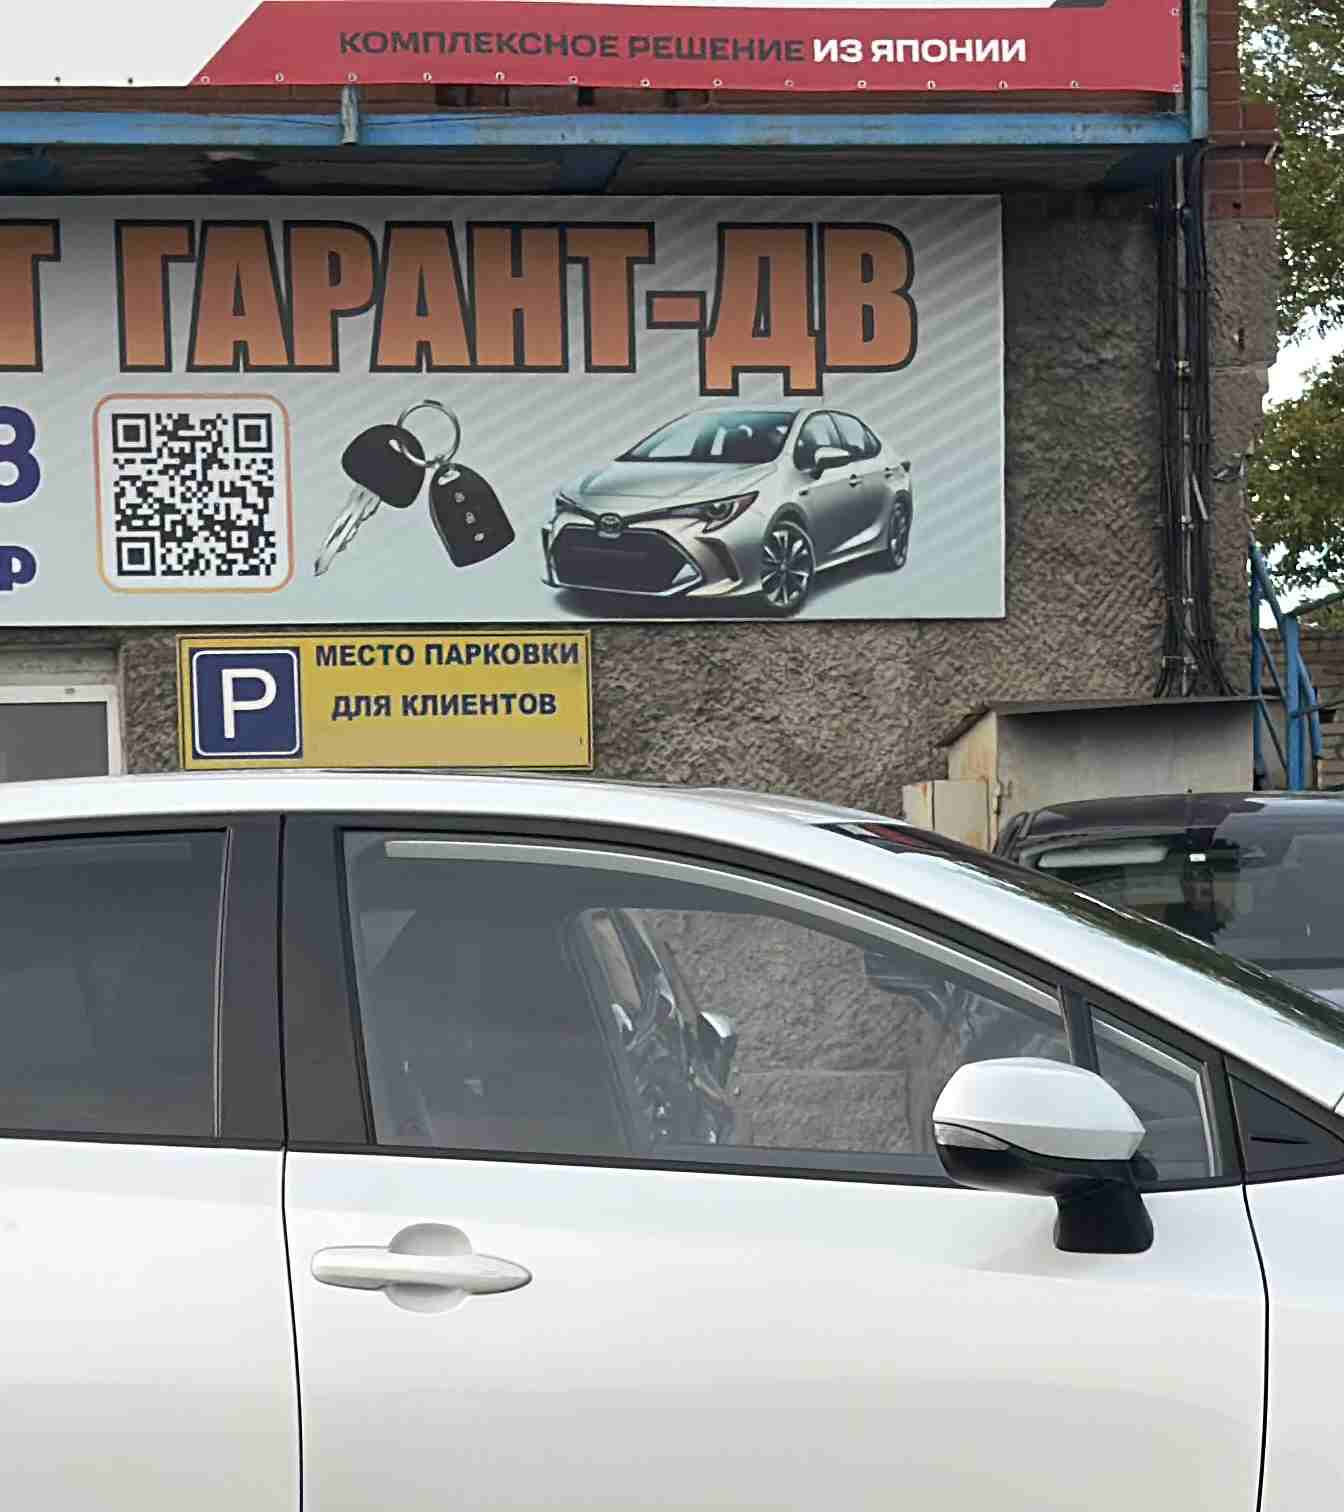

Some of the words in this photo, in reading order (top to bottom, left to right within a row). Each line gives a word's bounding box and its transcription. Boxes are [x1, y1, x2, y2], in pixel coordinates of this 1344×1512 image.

[339, 31, 619, 58] КОМПЛЕКСНОЕ
[628, 35, 805, 62] РЕШЕНИЕ
[812, 38, 863, 63] ИЗ
[870, 38, 1027, 64] ЯПОНИИ
[114, 219, 919, 397] ГАРАНТ-ДВ
[315, 643, 415, 667] МЕСТО
[424, 642, 580, 666] ПАРКОВКИ
[221, 667, 278, 740] P
[331, 694, 392, 721] ДЛЯ
[401, 692, 557, 717] КЛИЕНТОВ
